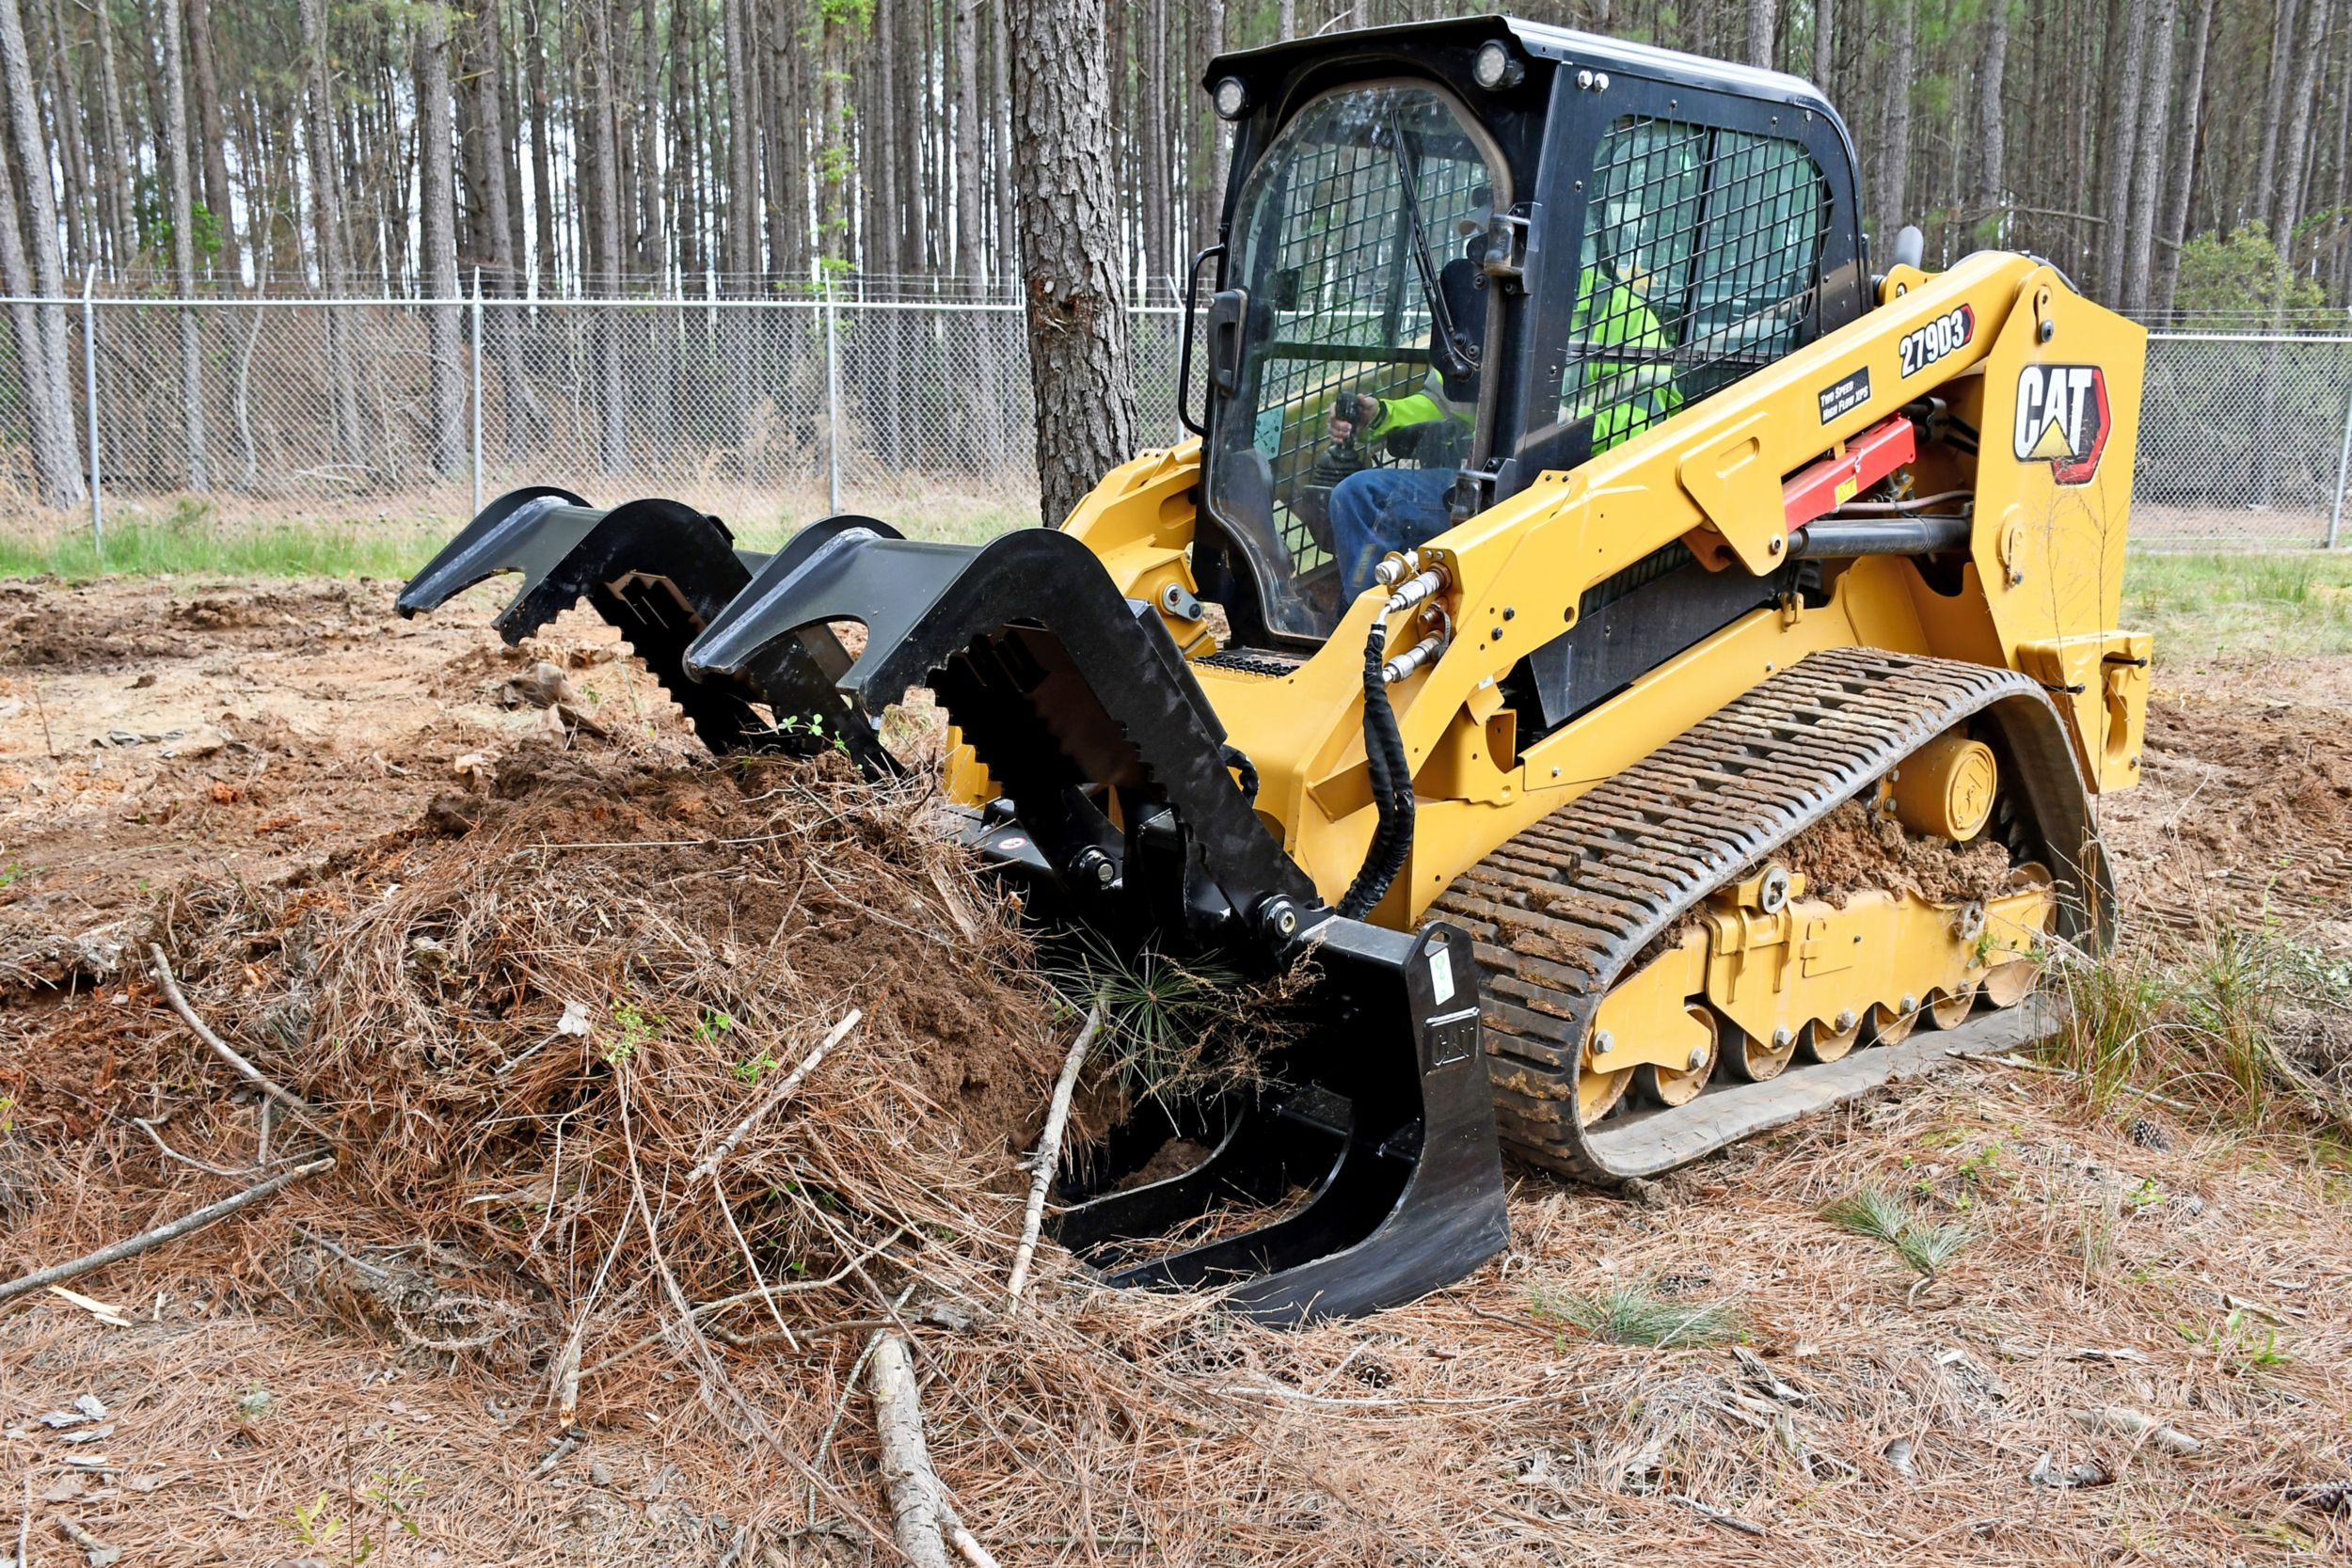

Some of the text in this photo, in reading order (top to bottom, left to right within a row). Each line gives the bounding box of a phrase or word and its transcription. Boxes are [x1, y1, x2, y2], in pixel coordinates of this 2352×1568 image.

[1899, 309, 1964, 377] 279D3
[1854, 385, 1868, 404] XPS
[2014, 366, 2093, 459] CAT
